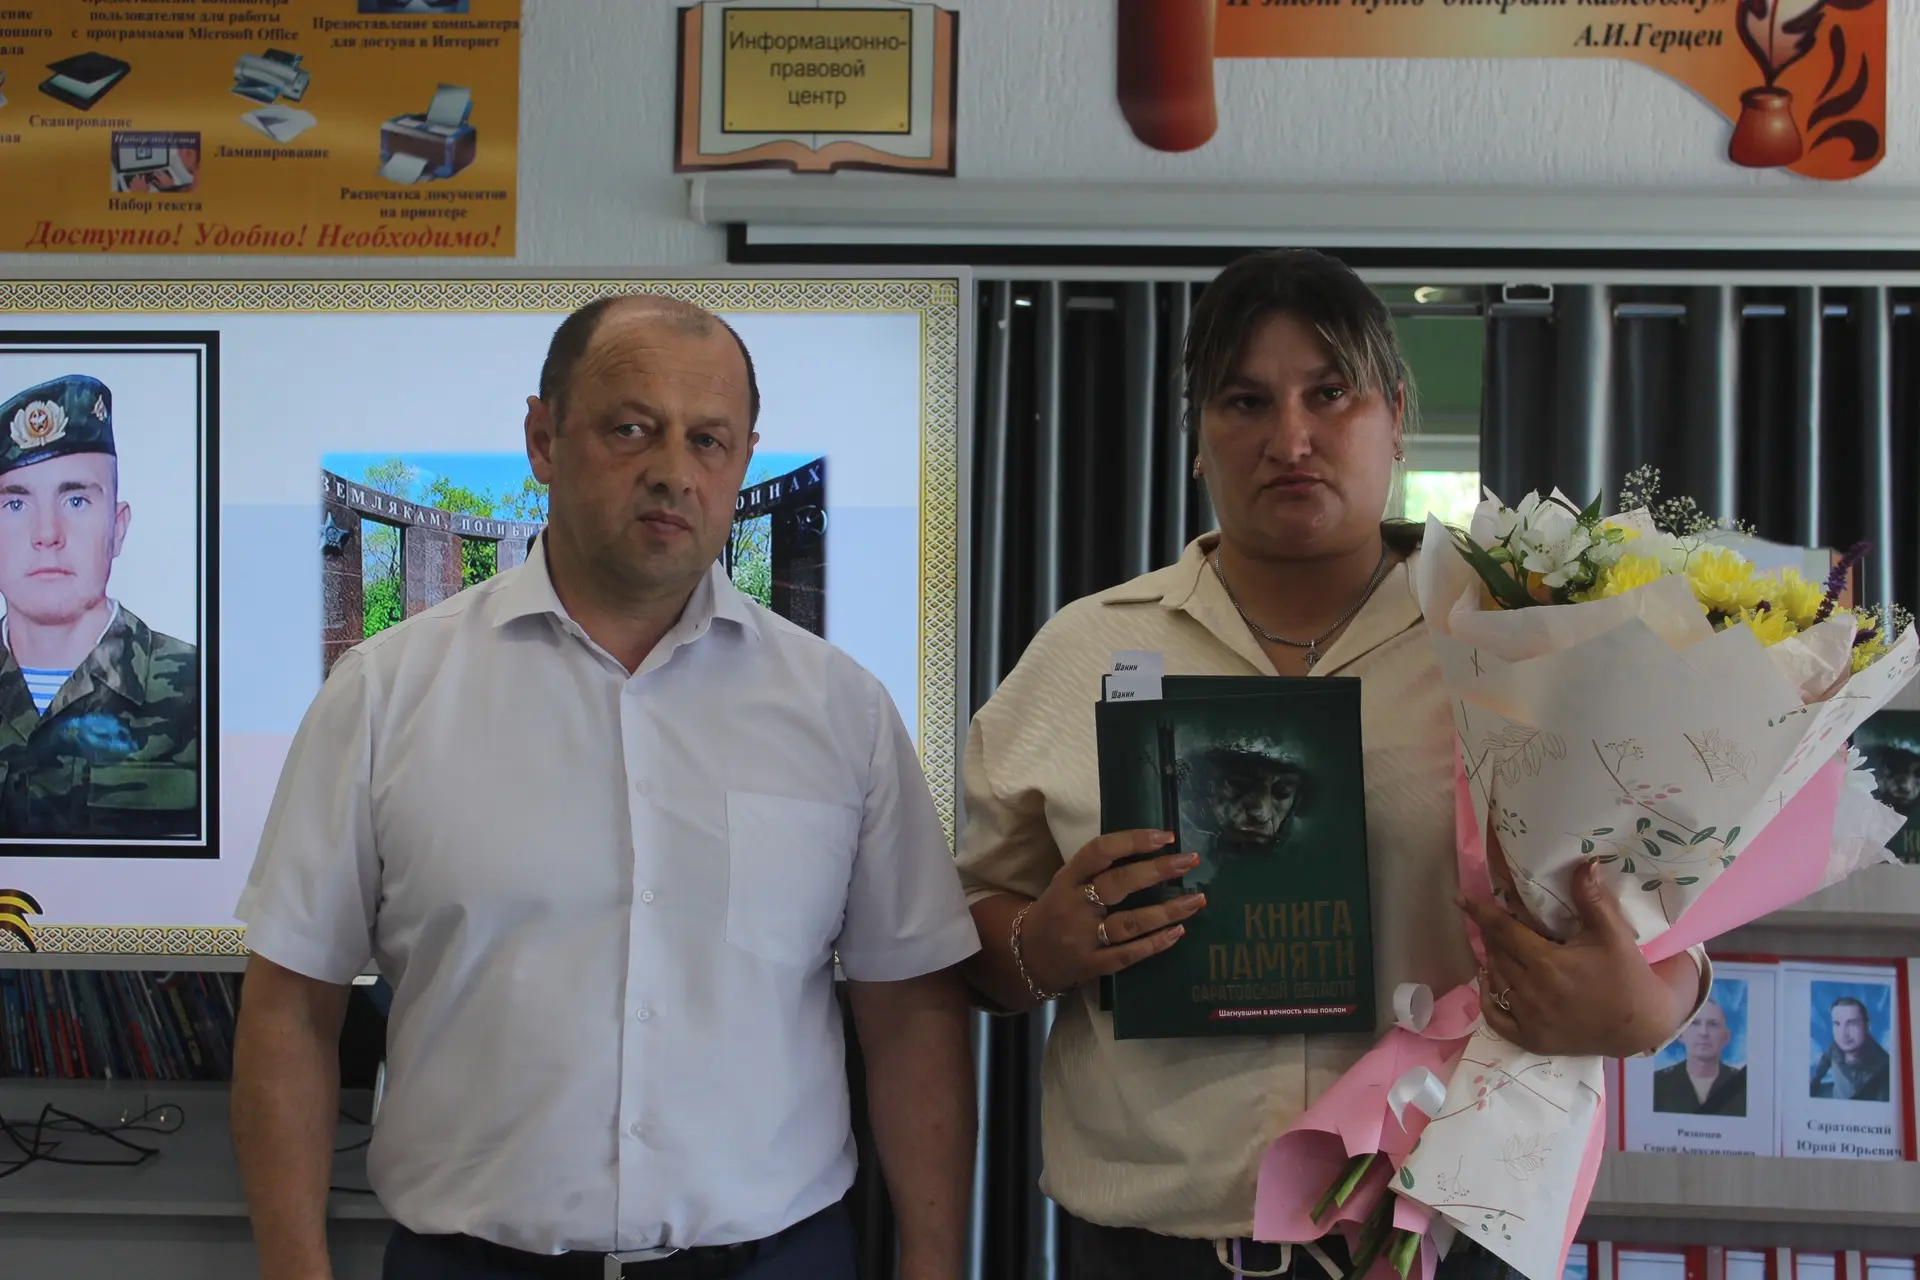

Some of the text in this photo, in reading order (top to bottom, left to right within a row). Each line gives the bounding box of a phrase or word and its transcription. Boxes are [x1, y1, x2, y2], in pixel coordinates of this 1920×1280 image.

[90, 11, 280, 25] пользователям для работы
[313, 17, 519, 33] Предоставление компьютера
[71, 27, 299, 41] с программами Microsoft Office
[331, 35, 500, 50] для доступа в Интернет
[729, 31, 907, 54] Информационно-
[1574, 23, 1723, 52] А.И.Герцен
[770, 60, 865, 80] правовой
[788, 89, 846, 109] центр
[29, 114, 132, 130] Сканирование
[215, 146, 330, 161] Ламинирование
[340, 188, 507, 203] Распечатка документов
[109, 198, 202, 214] Набор текста
[380, 208, 467, 220] на принтере
[26, 221, 501, 251] Доступно! Удобно! Необходимо!
[321, 475, 543, 538] ЗЕМЛЯКАМ, ПОГИБШ
[1244, 900, 1352, 939] КНИГА
[1208, 940, 1356, 980] ПАМЯТИ
[1192, 981, 1356, 1003] САРАТОВСКОЙ ОБЛАСТИ
[1219, 1009, 1262, 1018] Шагнувшим
[1269, 1008, 1302, 1016] вечность
[1807, 1119, 1892, 1136] Саратовский
[1797, 1139, 1902, 1158] Юрий Юрьевич
